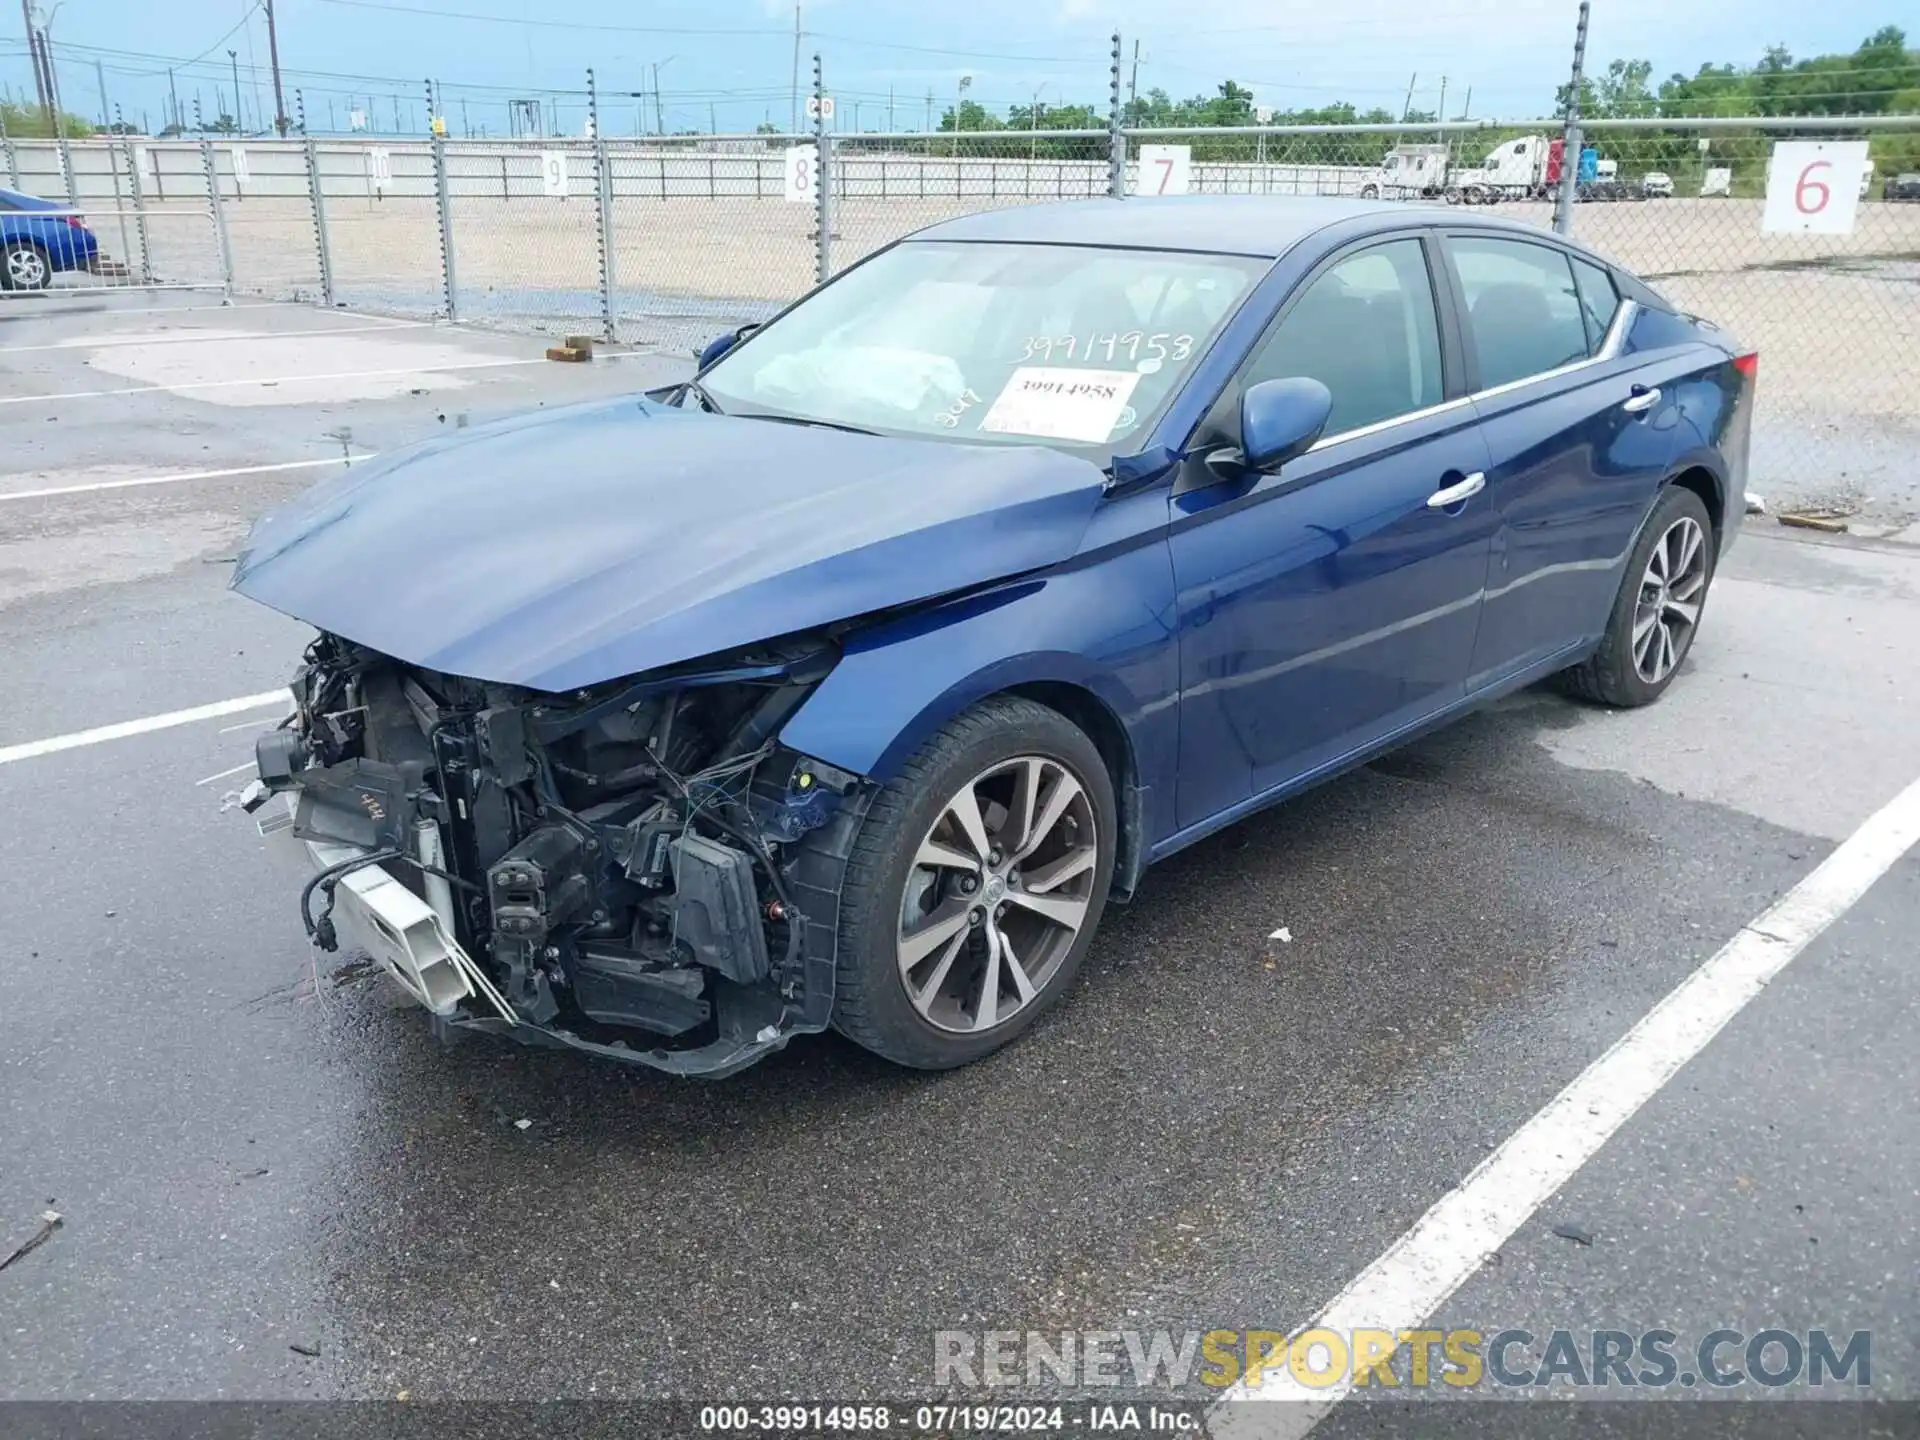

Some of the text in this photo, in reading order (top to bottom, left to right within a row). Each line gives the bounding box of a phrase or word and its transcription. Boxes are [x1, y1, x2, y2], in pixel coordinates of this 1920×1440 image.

[549, 159, 561, 186] 9
[795, 159, 809, 191] 8
[1154, 159, 1174, 195] 7
[1795, 160, 1832, 214] 6
[1006, 330, 1194, 364] 39914958
[1022, 380, 1117, 400] 39914958
